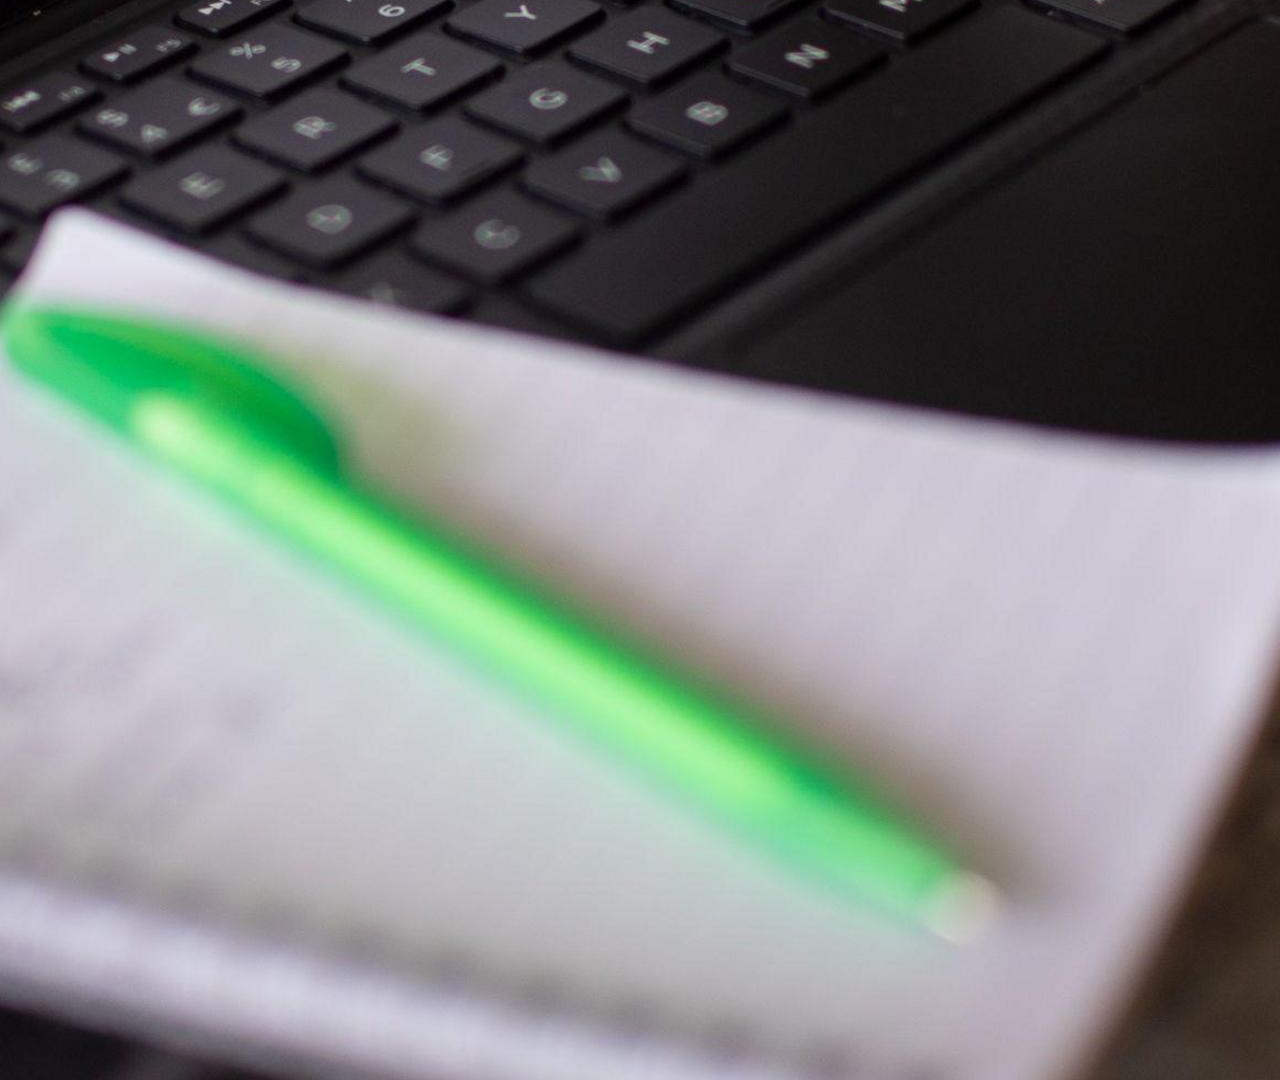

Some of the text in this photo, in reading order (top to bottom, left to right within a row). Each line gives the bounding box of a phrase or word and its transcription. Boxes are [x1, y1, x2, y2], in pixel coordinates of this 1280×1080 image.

[377, 2, 406, 18] 6
[503, 3, 537, 22] Y
[626, 30, 671, 55] H
[228, 41, 302, 73] % 5
[400, 57, 437, 77] T
[783, 42, 831, 69] N
[529, 86, 569, 110] G
